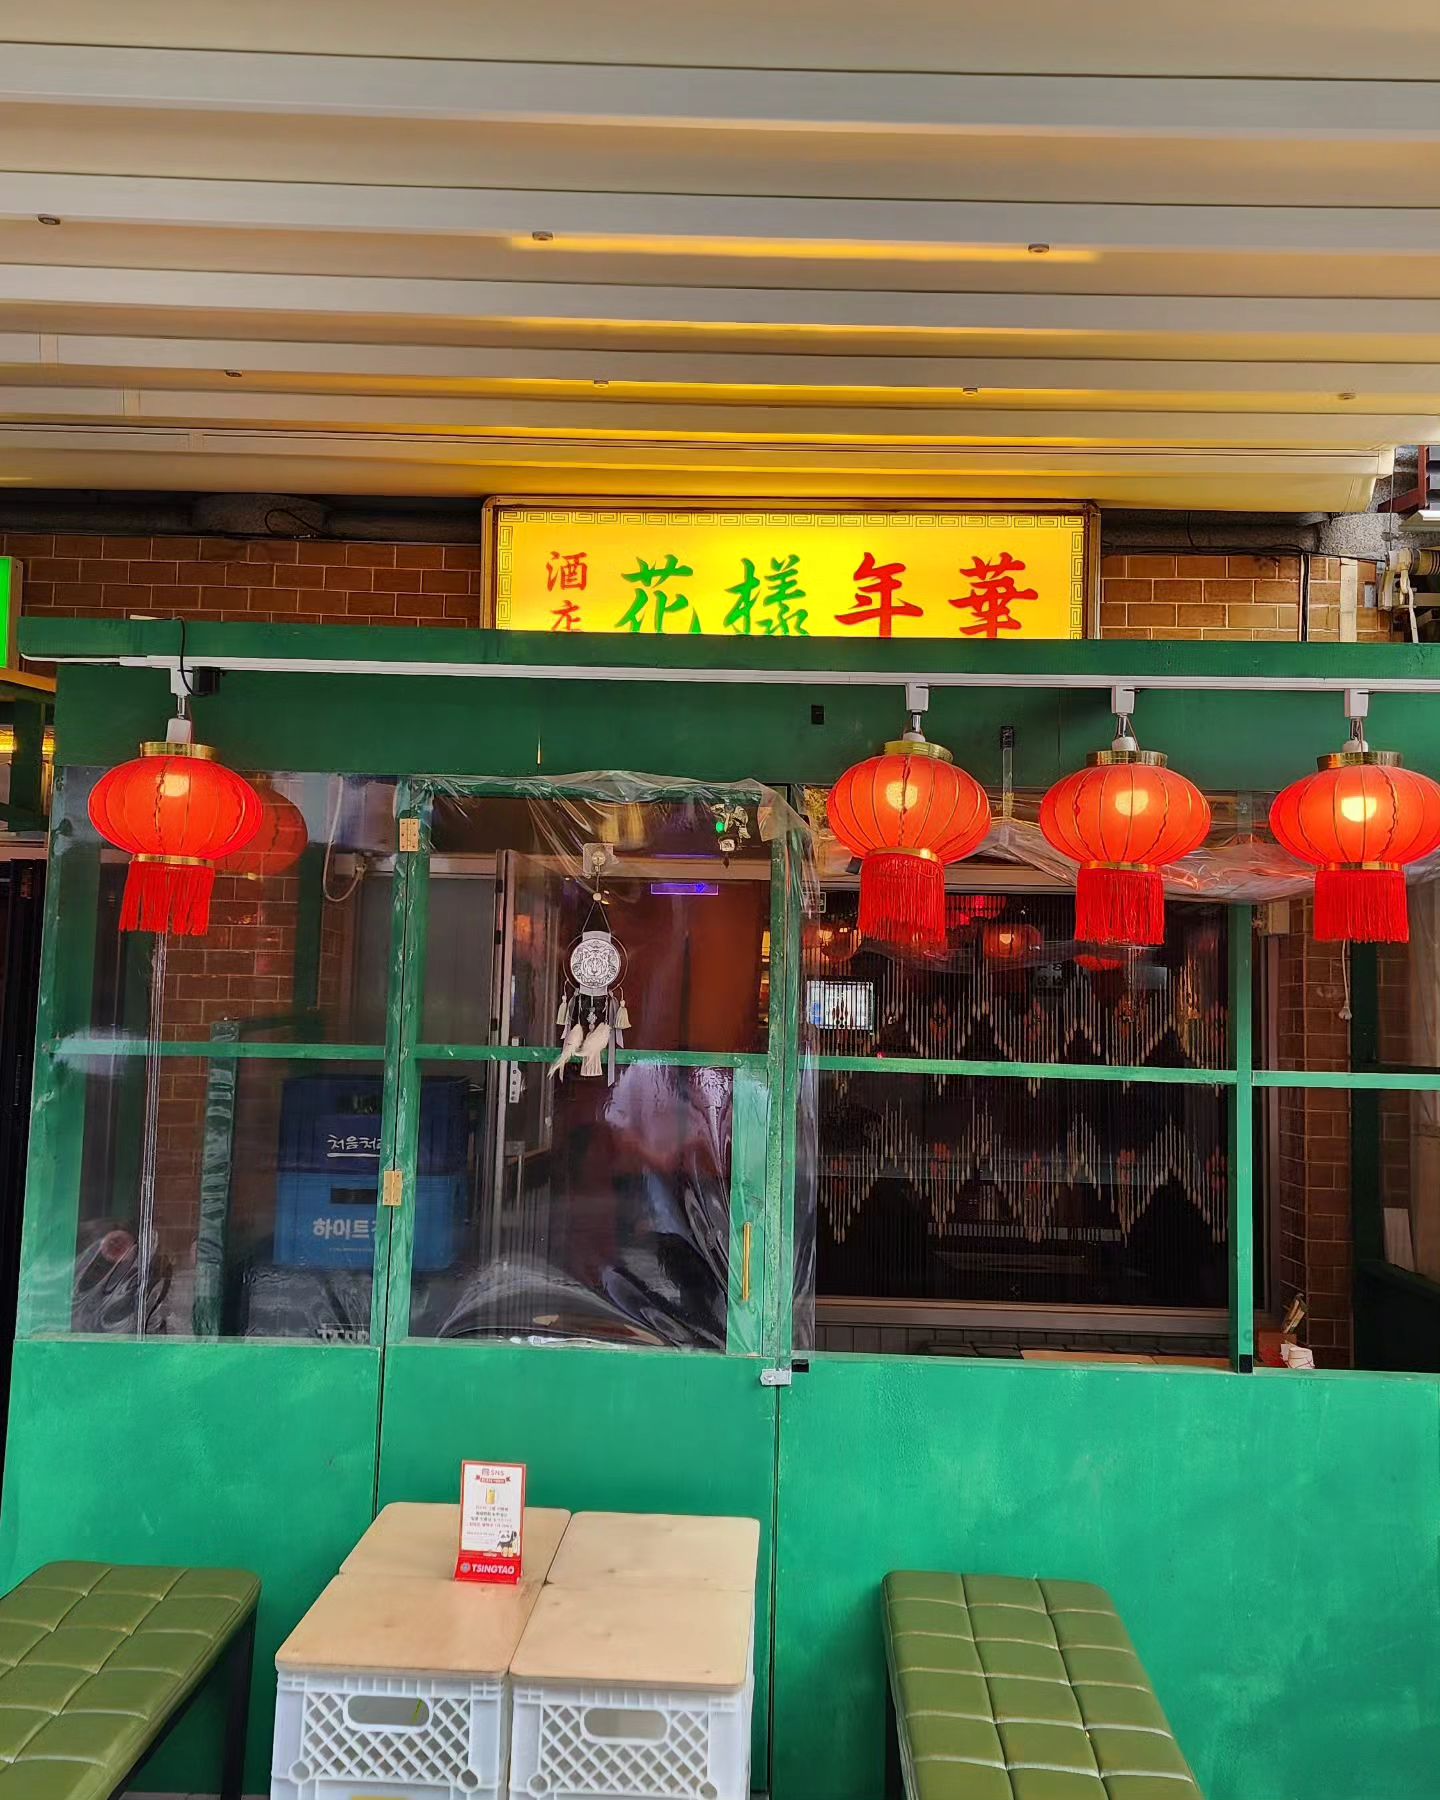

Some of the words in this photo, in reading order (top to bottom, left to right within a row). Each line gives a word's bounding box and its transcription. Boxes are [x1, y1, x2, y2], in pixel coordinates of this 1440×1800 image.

[327, 1134, 382, 1150] 처음처
[313, 1218, 377, 1240] 하이트
[472, 1563, 515, 1576] TSINGTAO
